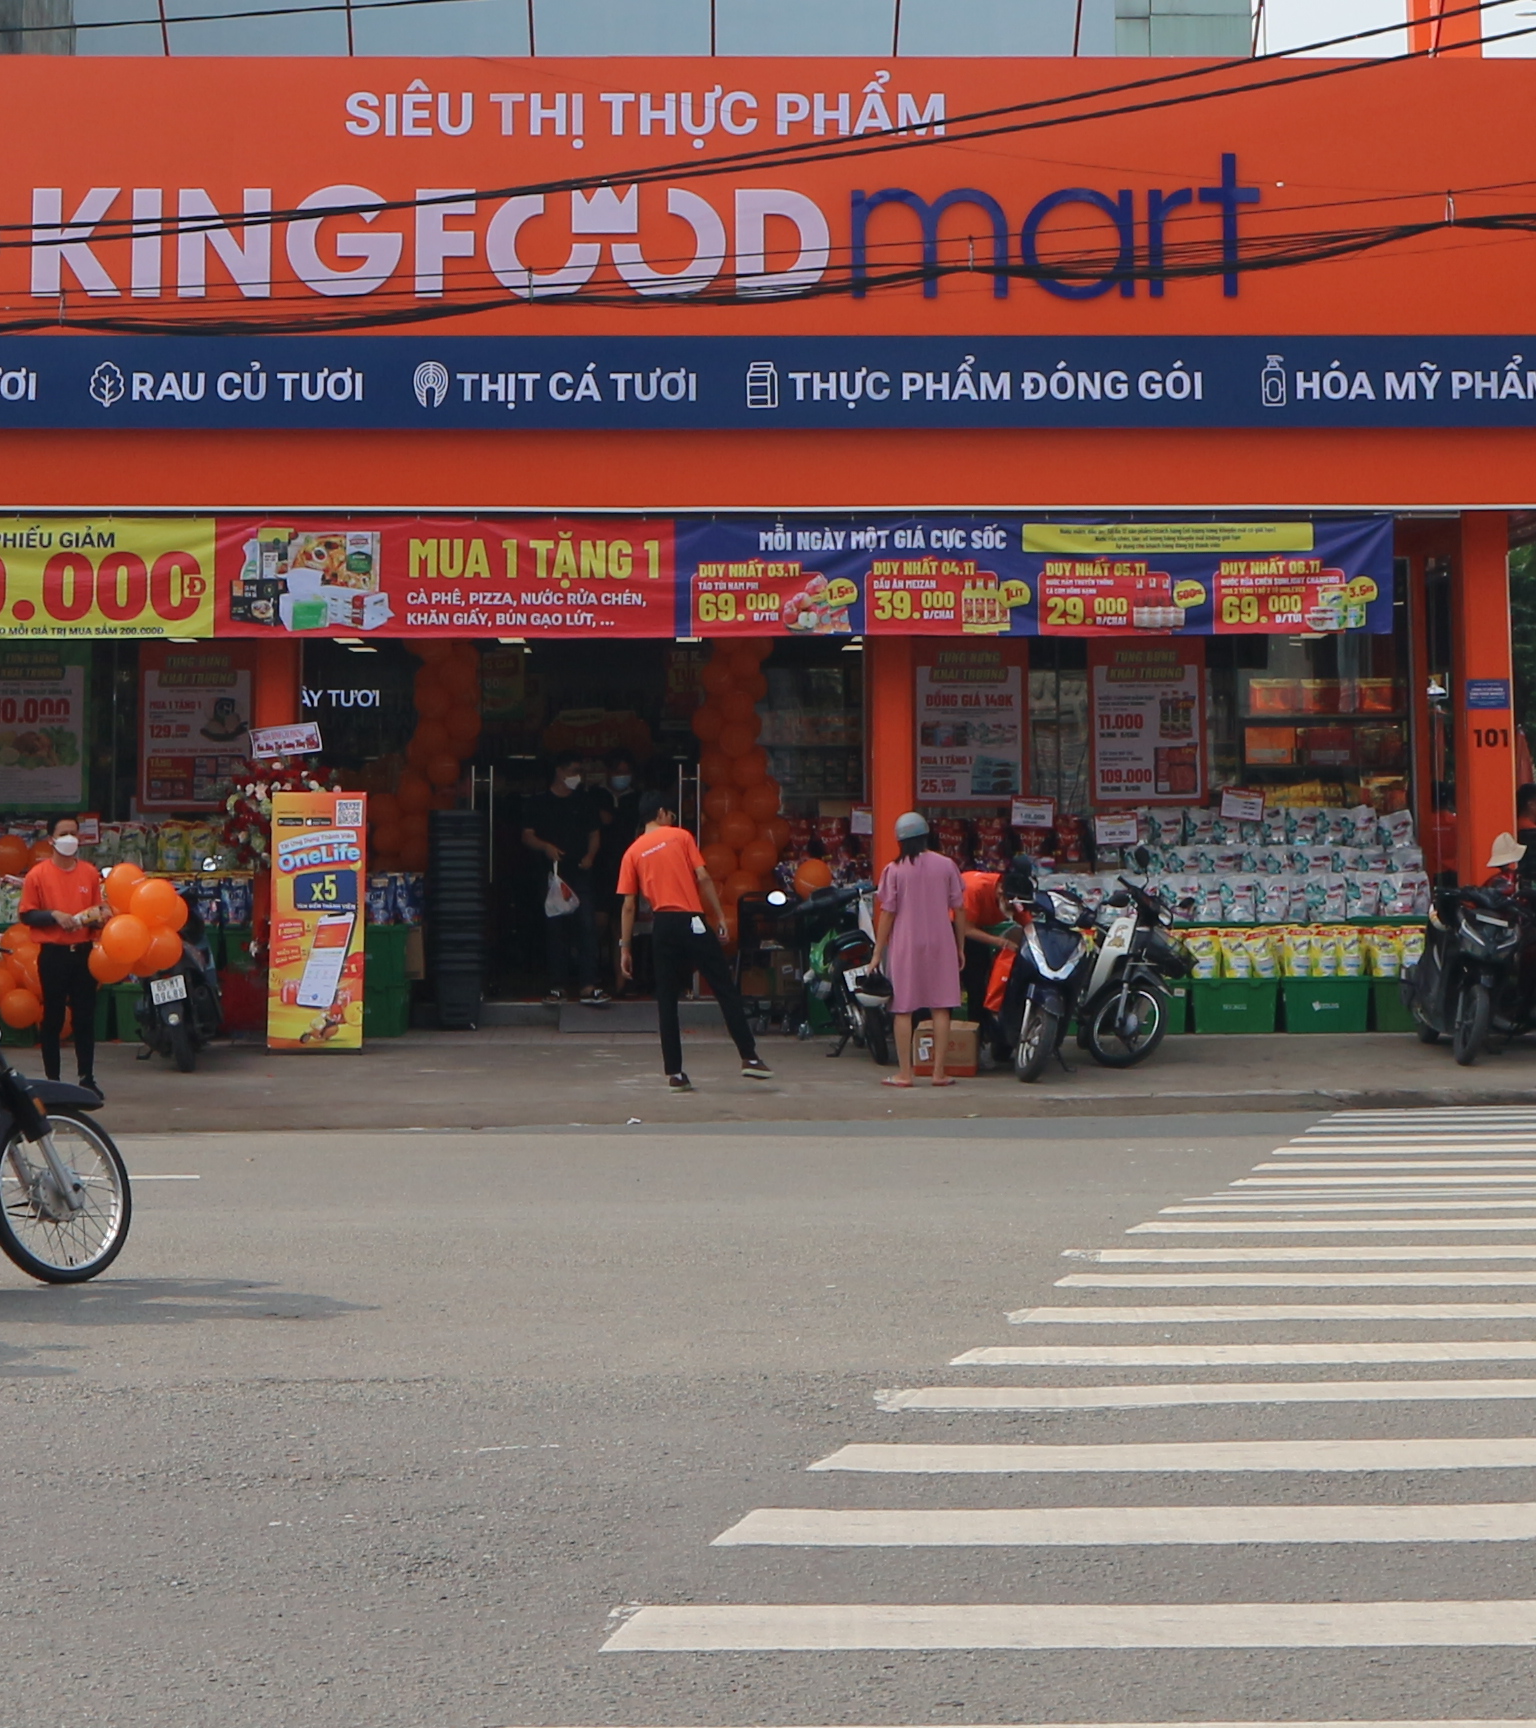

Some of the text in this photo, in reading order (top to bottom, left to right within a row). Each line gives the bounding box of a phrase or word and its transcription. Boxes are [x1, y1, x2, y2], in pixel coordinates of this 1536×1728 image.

[345, 71, 945, 149] SIÊU THỊ THỰC PHẨM
[133, 360, 364, 401] RAU CỦ TƯƠI
[457, 361, 698, 410] THỊT CÁ TƯƠI
[789, 355, 1204, 410] THỰC PHẨM ĐÓNG GÓI
[1296, 360, 1375, 401] HÓA
[1385, 357, 1441, 401] MỸ
[59, 526, 116, 549] GIẢM
[759, 524, 1007, 553] MỖI NGÀY MỘT GIÁ CỰC SỐC
[407, 531, 660, 589] MUA 1 TẶNG 1
[698, 558, 800, 578] DUY NHẤT 03.11
[873, 556, 975, 576] DUY NHẤT 04.11
[1045, 557, 1146, 576] DUY NHẤT 05.11
[1220, 555, 1321, 575] DUY NHẤT 06.11
[407, 589, 647, 608] CÀ PHÊ, PIZZA, NƯỚC RỬA CHÉN,
[407, 607, 597, 629] KHĂN GIẤY, BÚN GẠO LỨT,
[9, 624, 29, 636] MỖI
[31, 624, 49, 636] GIÁ
[51, 626, 66, 638] TRỊ
[68, 626, 92, 636] MUA
[93, 623, 117, 636] SẮM
[329, 688, 380, 707] TƯƠI
[926, 689, 1014, 707] ĐỒNG GIÁ 149K
[1098, 714, 1144, 730] 11.000
[1473, 728, 1508, 748] 101
[278, 843, 362, 872] OneLife
[311, 874, 338, 902] x5
